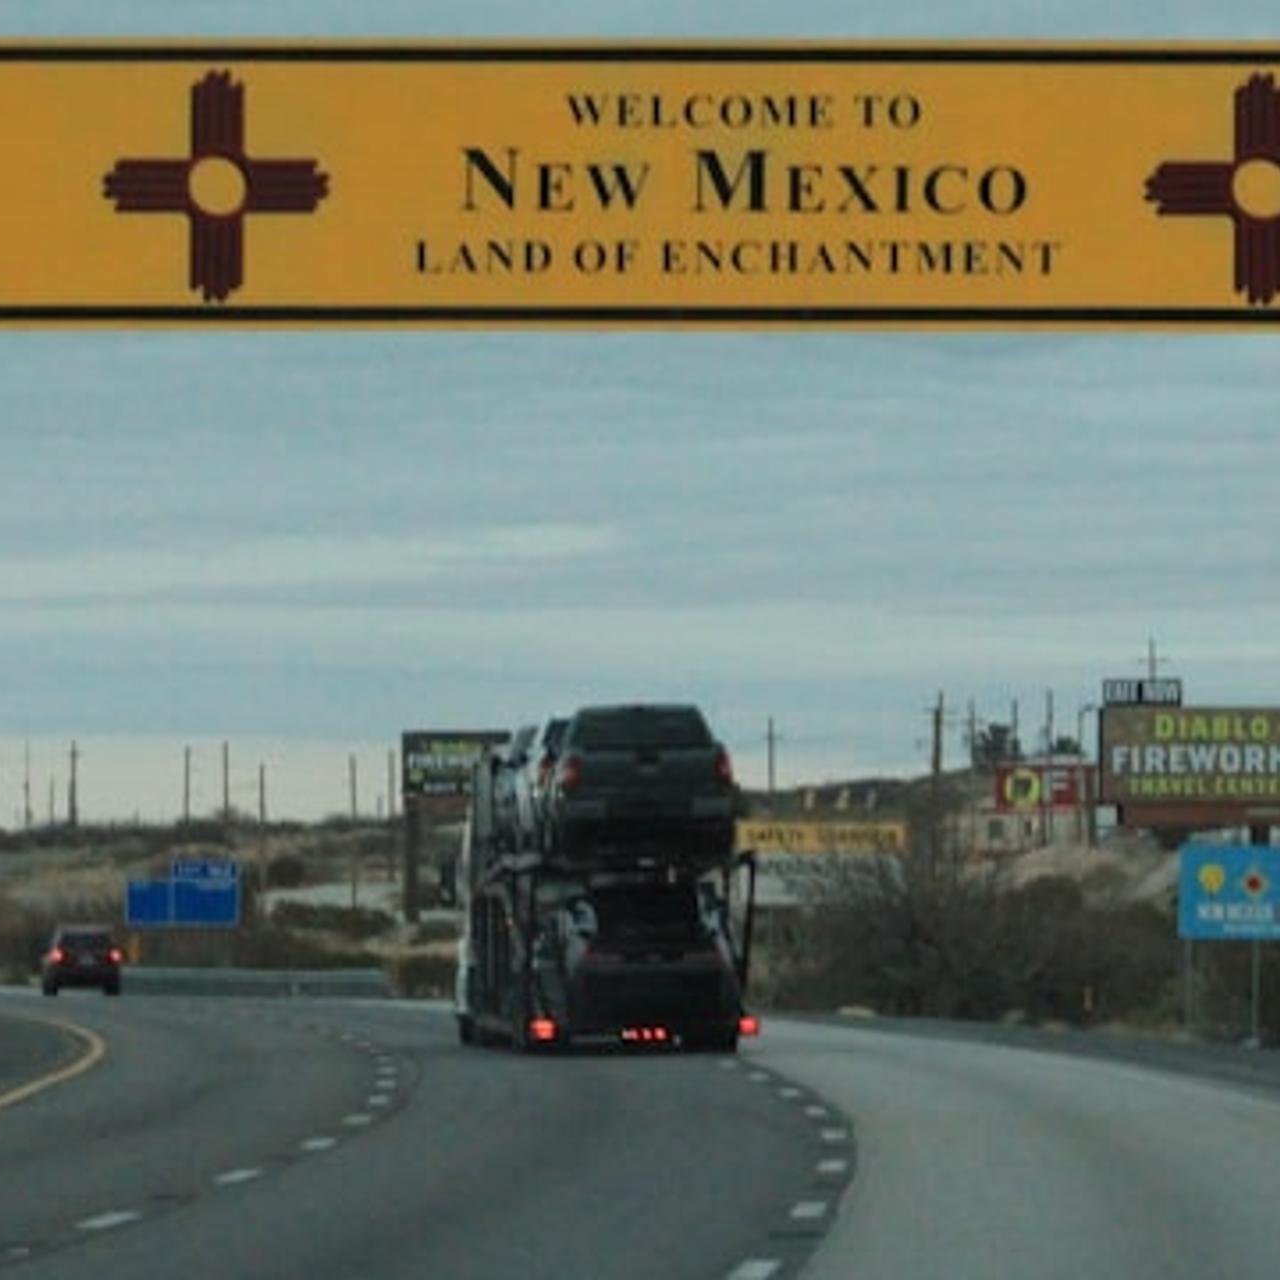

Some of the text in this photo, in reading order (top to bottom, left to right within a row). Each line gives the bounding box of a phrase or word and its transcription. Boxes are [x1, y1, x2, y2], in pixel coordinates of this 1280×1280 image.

[567, 93, 922, 128] WELCOME TO
[461, 147, 1028, 215] NEW MEXICO
[414, 239, 1062, 275] LAND OF ENCHANTMENT
[1154, 714, 1270, 739] DIABLO
